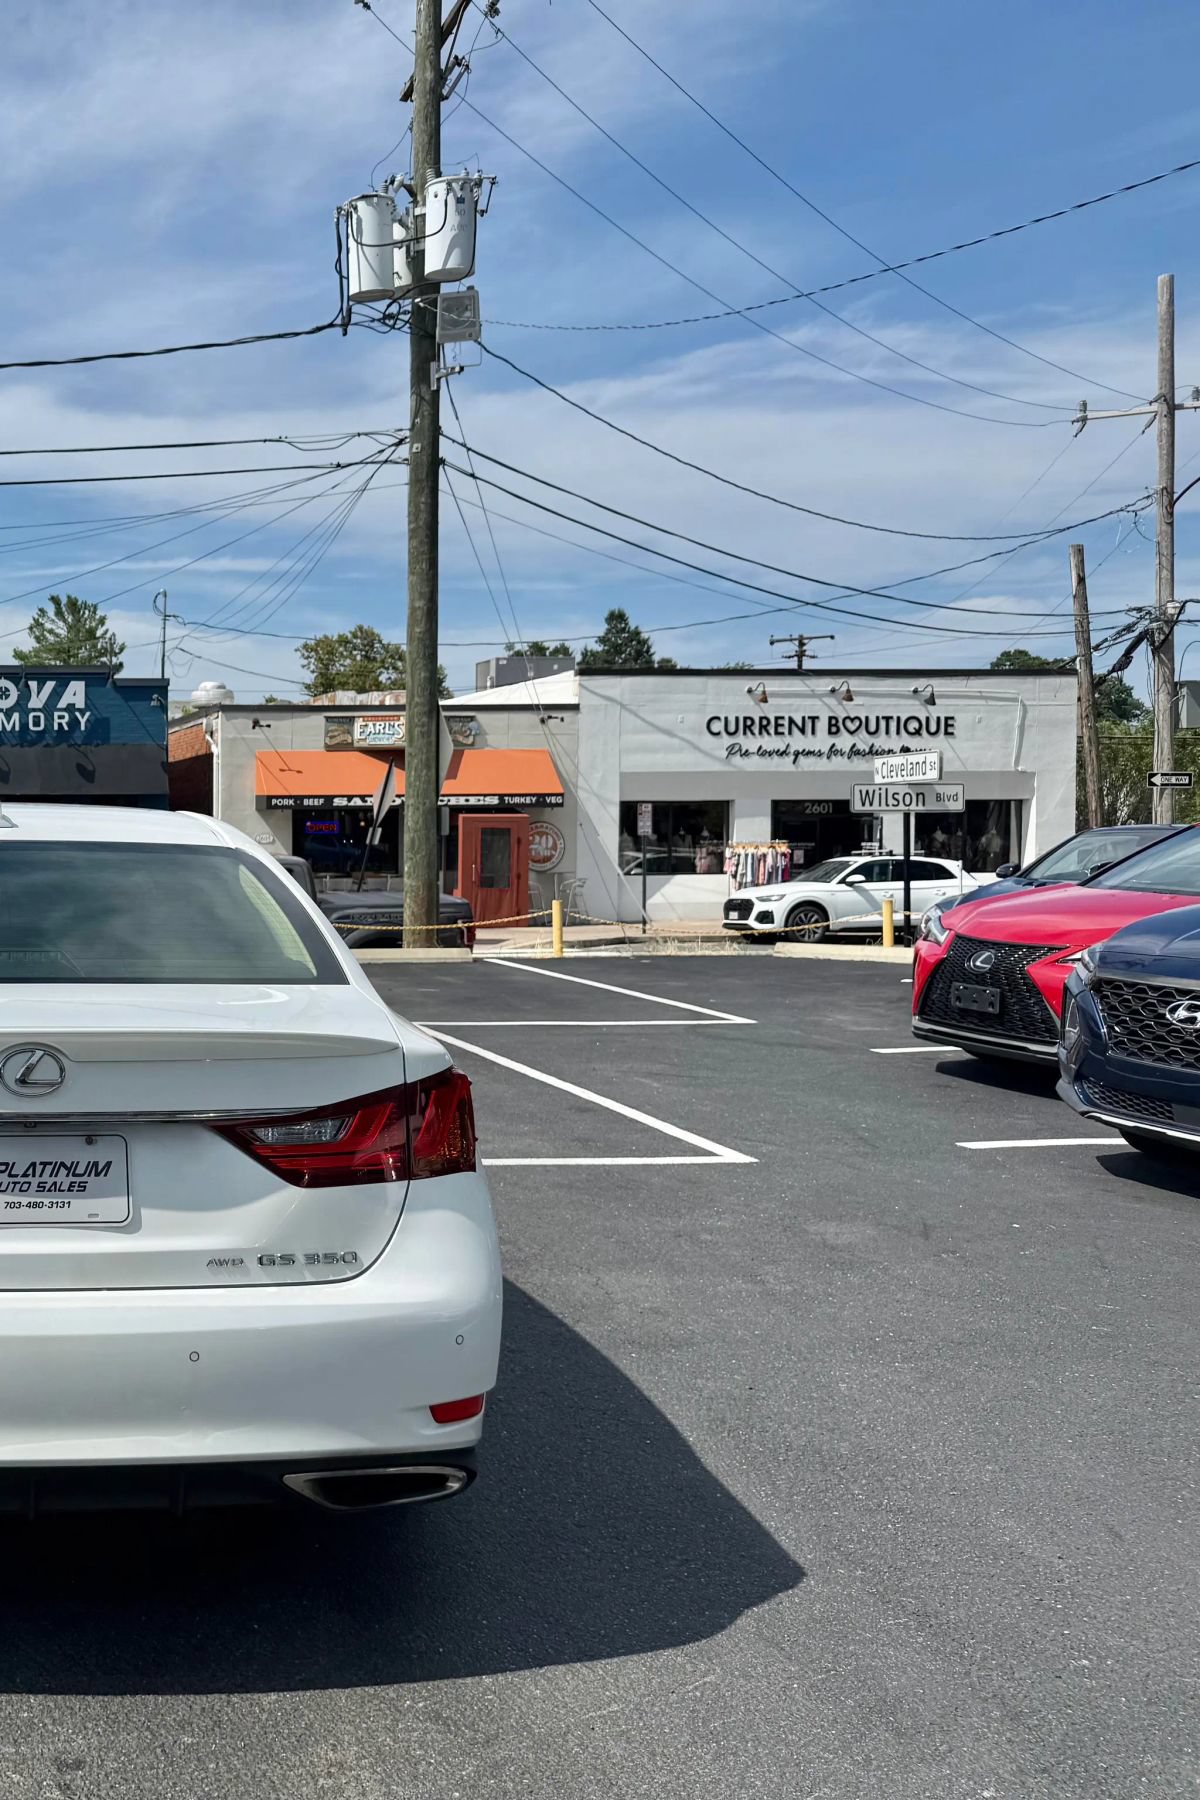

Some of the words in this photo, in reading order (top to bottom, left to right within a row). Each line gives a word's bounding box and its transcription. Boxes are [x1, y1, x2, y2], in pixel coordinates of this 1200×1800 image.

[357, 721, 405, 740] EARL'S
[705, 715, 820, 737] CURRENT
[827, 715, 956, 737] BOUTIQUE
[725, 742, 790, 760] Pre-loved
[792, 749, 823, 764] gems
[826, 743, 845, 762] for
[847, 743, 896, 762] fashion
[881, 756, 927, 780] Cleveland
[929, 760, 937, 771] St
[271, 798, 295, 806] PORK
[303, 798, 325, 806] BEEF
[503, 796, 536, 804] TURKEY
[545, 795, 563, 804] VEG
[859, 788, 926, 808] Wilson
[935, 792, 959, 803] Blvd
[804, 803, 833, 814] 2601
[308, 823, 337, 832] OPEN
[35, 1181, 88, 1193] SALES
[4, 1201, 71, 1209] 703-480-3131
[206, 1257, 244, 1267] AWD
[256, 1253, 296, 1266] GS
[303, 1251, 358, 1265] 350
